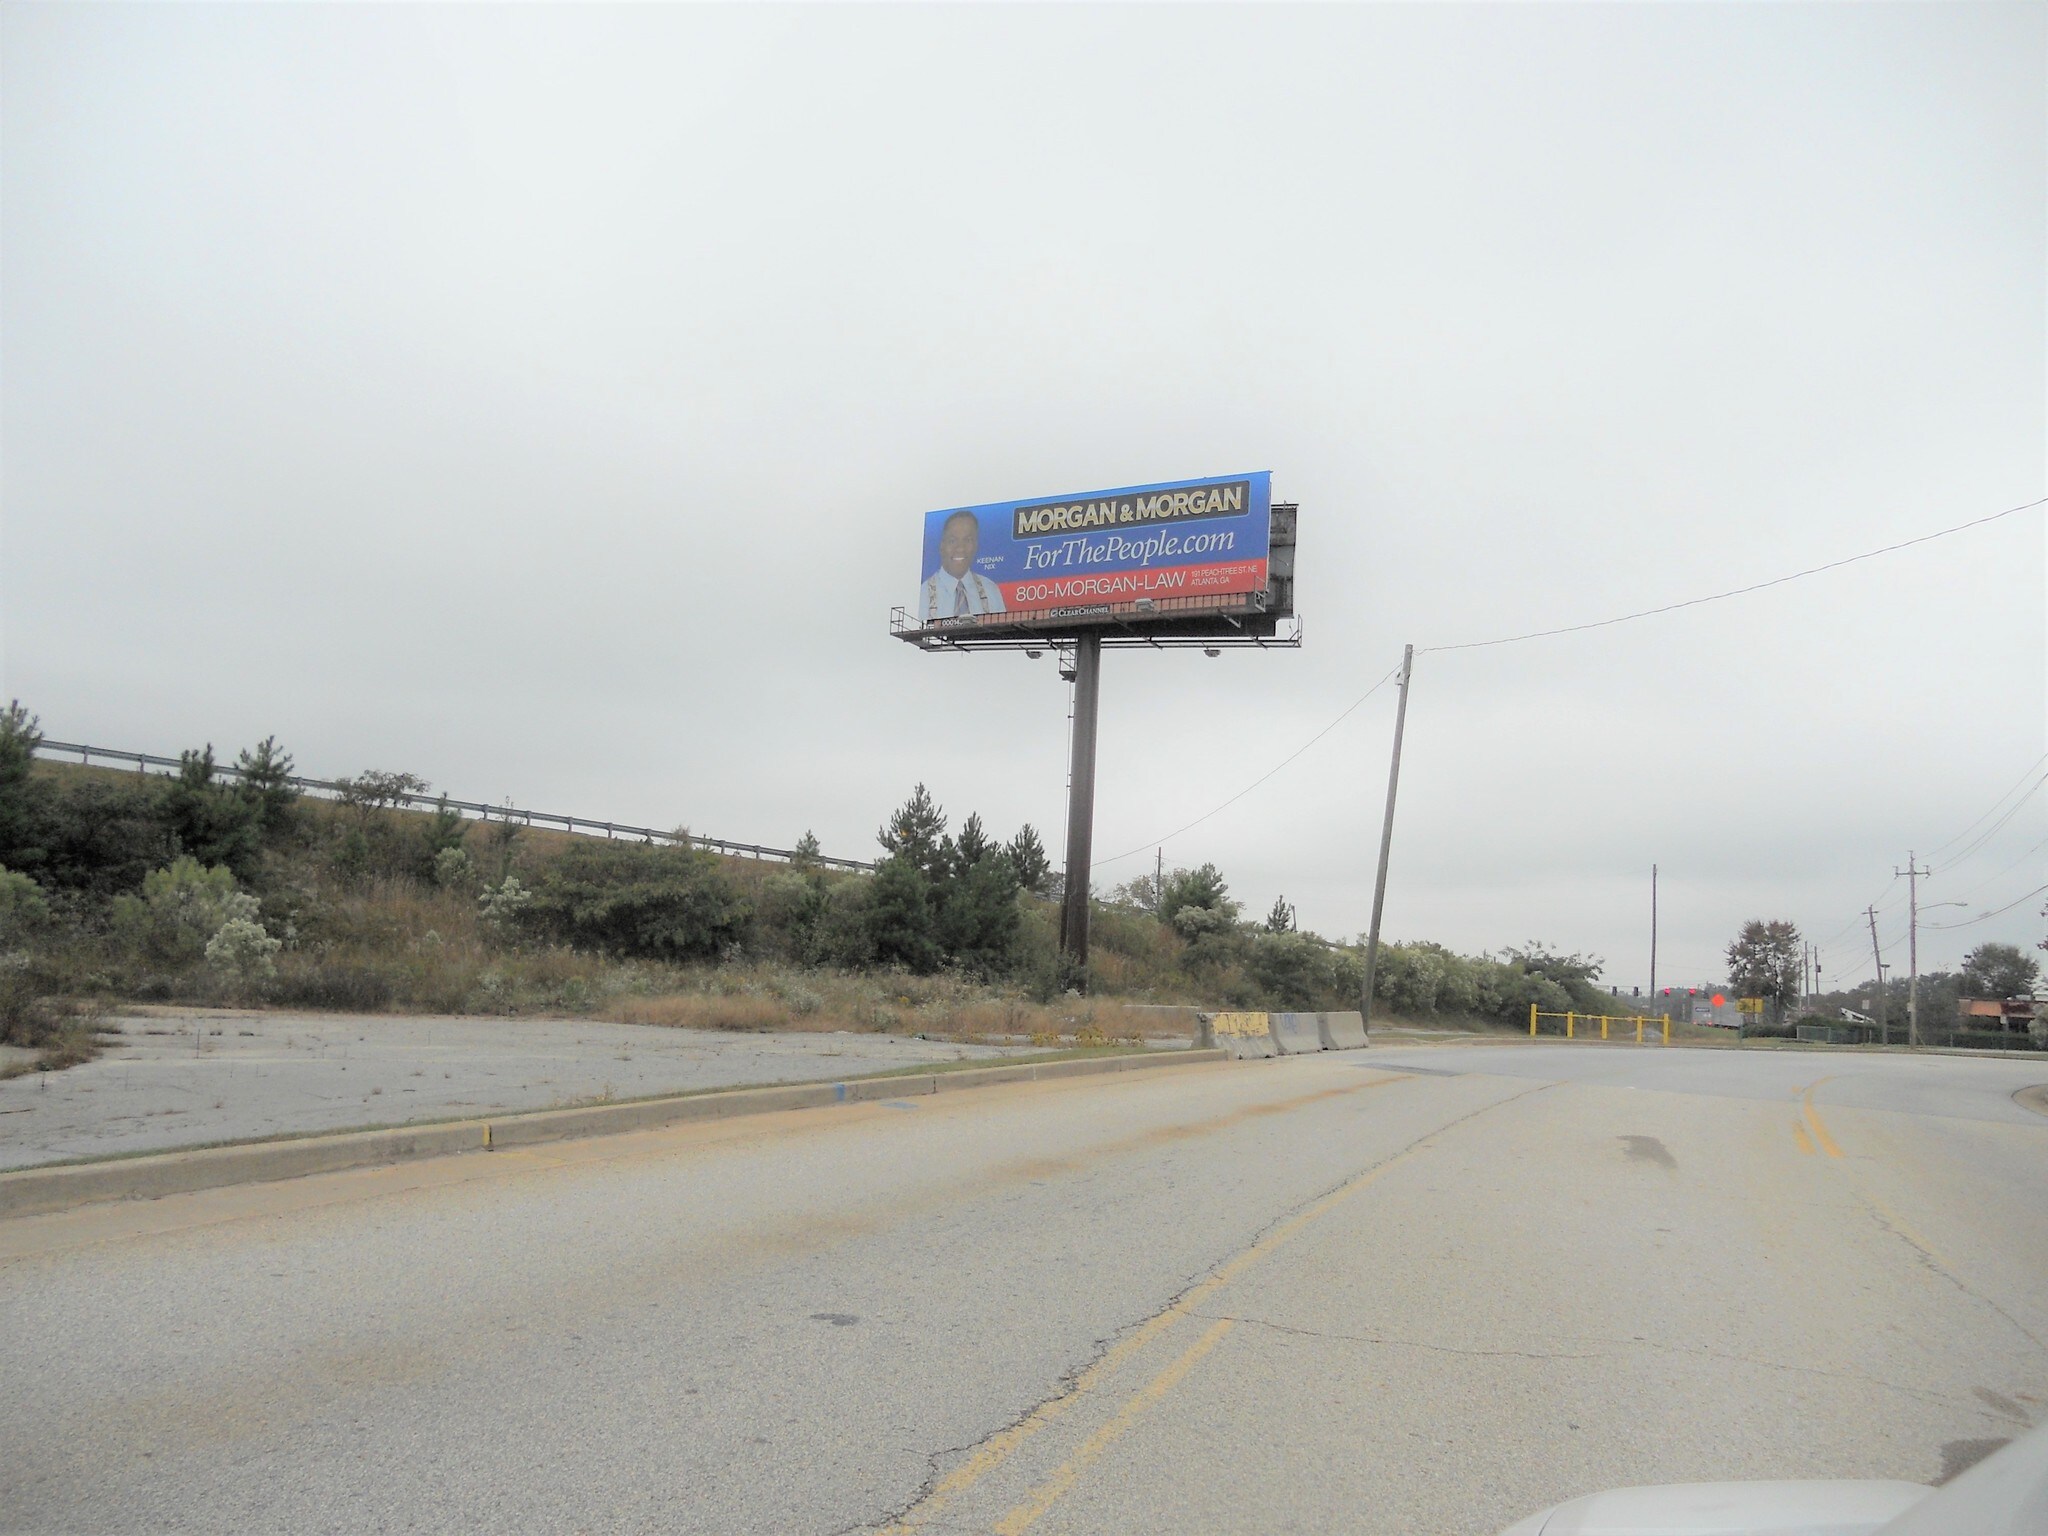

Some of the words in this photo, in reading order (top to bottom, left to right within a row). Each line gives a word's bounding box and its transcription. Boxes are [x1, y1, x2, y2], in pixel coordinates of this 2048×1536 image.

[1017, 501, 1117, 534] MORGAN
[1119, 503, 1135, 523] &
[1135, 486, 1242, 520] MORGAN
[976, 556, 1004, 564] KEENAN
[1023, 529, 1235, 571] ForThePeople.com
[1200, 566, 1238, 577] PEACHTREE
[1248, 564, 1258, 573] NE
[1219, 575, 1230, 584] GA
[1015, 571, 1187, 603] 800-MORGAN-LAW
